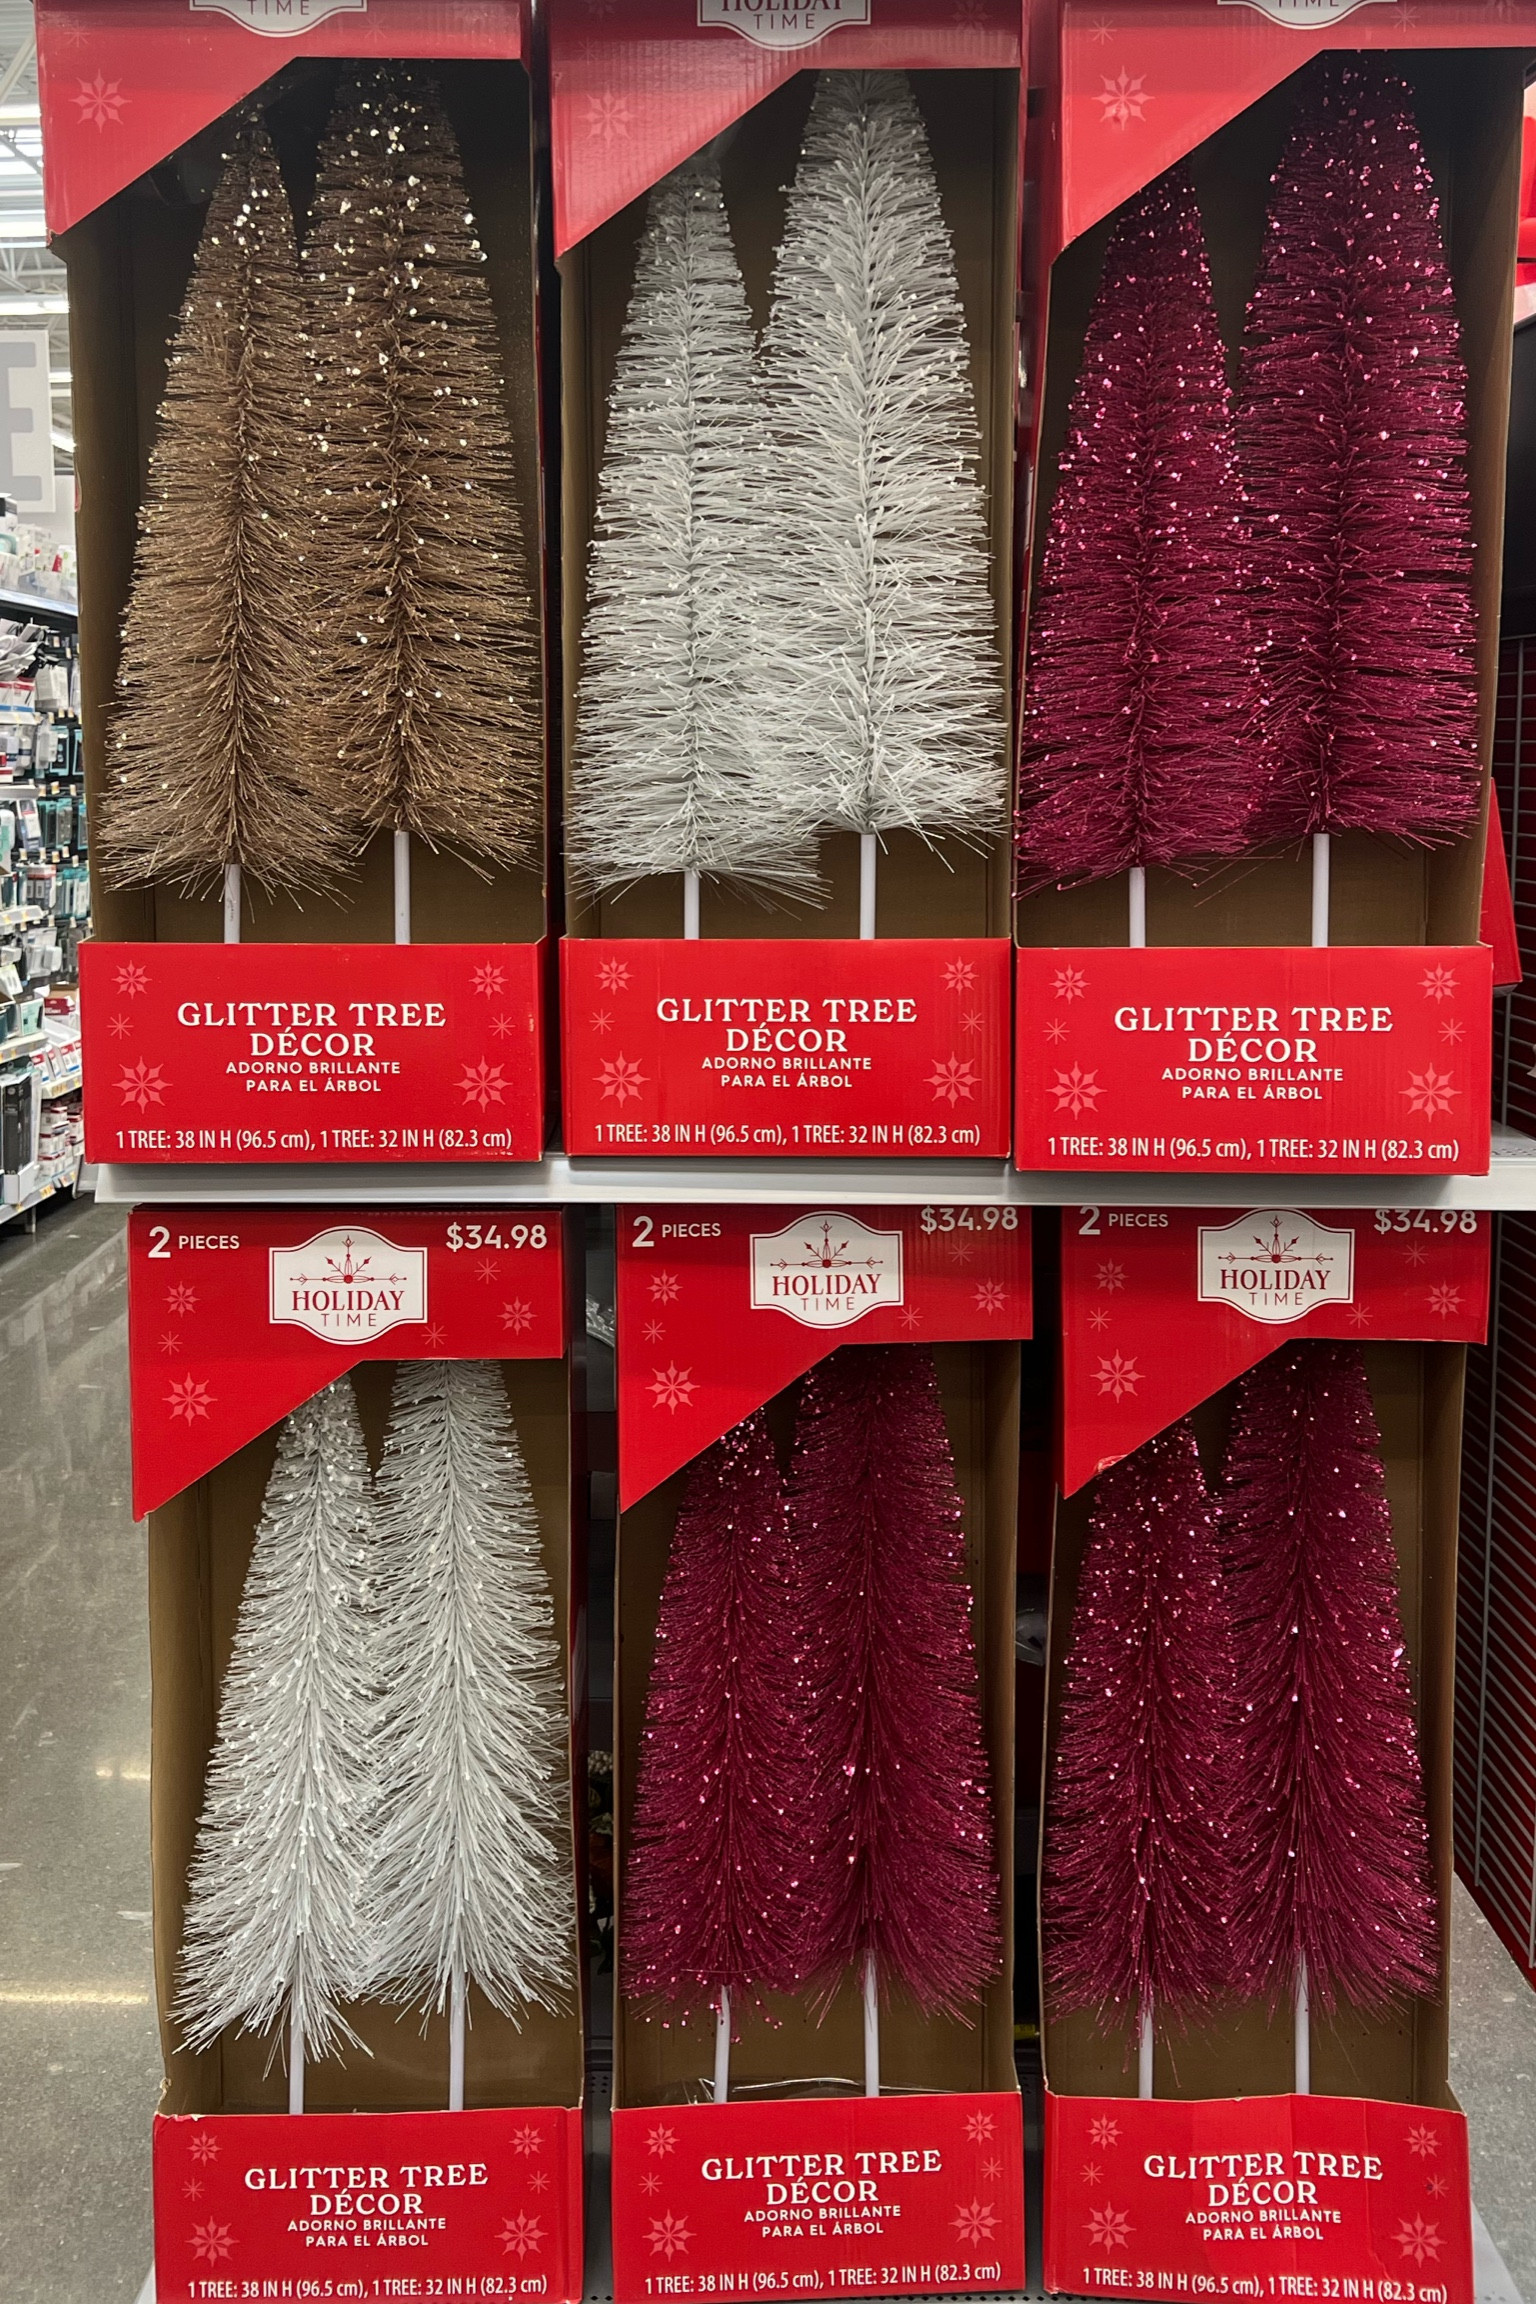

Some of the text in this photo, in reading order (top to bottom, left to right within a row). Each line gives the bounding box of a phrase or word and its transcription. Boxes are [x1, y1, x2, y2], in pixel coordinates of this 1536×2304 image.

[247, 0, 310, 15] TIME
[753, 13, 815, 29] TIME
[178, 1003, 445, 1026] GLITTER TREE
[657, 998, 917, 1022] GLITTER TREE
[1115, 1007, 1393, 1031] GLITTER TREE
[250, 1027, 375, 1056] DÉCOR
[727, 1022, 847, 1052] DÉCOR
[1189, 1032, 1317, 1062] DÉCOR
[226, 1062, 400, 1074] ADORNO BRILLANTE
[702, 1057, 871, 1069] ADORNO BRILLANTE
[247, 1077, 381, 1091] PARA EL ÁRBOL
[722, 1073, 852, 1087] PARA EL ÁRBOL
[1162, 1068, 1343, 1081] ADORNO BRILLANTE
[1183, 1084, 1322, 1099] PARA EL ÁRBOL
[115, 1129, 511, 1151] 1 TREE: 38 IN H (96.5 cm), 1 TREE: 32 IN H (82.3 cm)
[594, 1124, 980, 1145] 1 TREE: 38 IN H (96.5 cm), 1 TREE: 32 IN H (82.3 cm)
[1048, 1137, 1458, 1161] 1 TREE: 38 IN H (96.5 cm), 1 TREE: 32 IN H (82.3 cm)
[920, 1206, 1017, 1234] $34.98
[1078, 1206, 1168, 1235] 2 PIECES
[1374, 1210, 1476, 1234] $34.98
[148, 1226, 239, 1258] 2 PIECES
[446, 1222, 547, 1252] $34.98
[632, 1216, 721, 1247] 2 PIECES
[773, 1274, 881, 1295] HOLIDAY
[1221, 1269, 1330, 1289] HOLIDAY
[293, 1291, 404, 1311] HOLIDAY
[801, 1297, 854, 1311] TIME
[1249, 1292, 1303, 1305] TIME
[321, 1313, 376, 1326] TIME
[245, 2163, 488, 2189] GLITTER TREE
[702, 2150, 941, 2181] GLITTER TREE
[1144, 2151, 1382, 2180] GLITTER TREE
[767, 2176, 878, 2204] DÉCOR
[1209, 2177, 1317, 2206] DÉCOR
[311, 2188, 423, 2215] DÉCOR
[288, 2218, 445, 2231] ADORNO BRILLANTE
[744, 2206, 900, 2222] ADORNO BRILLANTE
[1186, 2209, 1341, 2223] ADORNO BRILLANTE
[306, 2233, 428, 2247] PARA EL ÁRBOL
[763, 2222, 883, 2237] PARA EL ÁRBOL
[1204, 2224, 1323, 2240] PARA EL ÁRBOL
[188, 2275, 547, 2299] 1 TREE: 38 IN H (96.5 cm), 1 TREE: 32 IN H (82.3 cm)
[644, 2262, 1000, 2294] 1 TREE: 38 IN H (96.5 cm), 1 TREE: 32 IN H (82.3 cm)
[1082, 2268, 1447, 2304] 1 TREE: 38 IN H (96.5 cm), 1 TREE: 32 IN H (82.3 cm)
